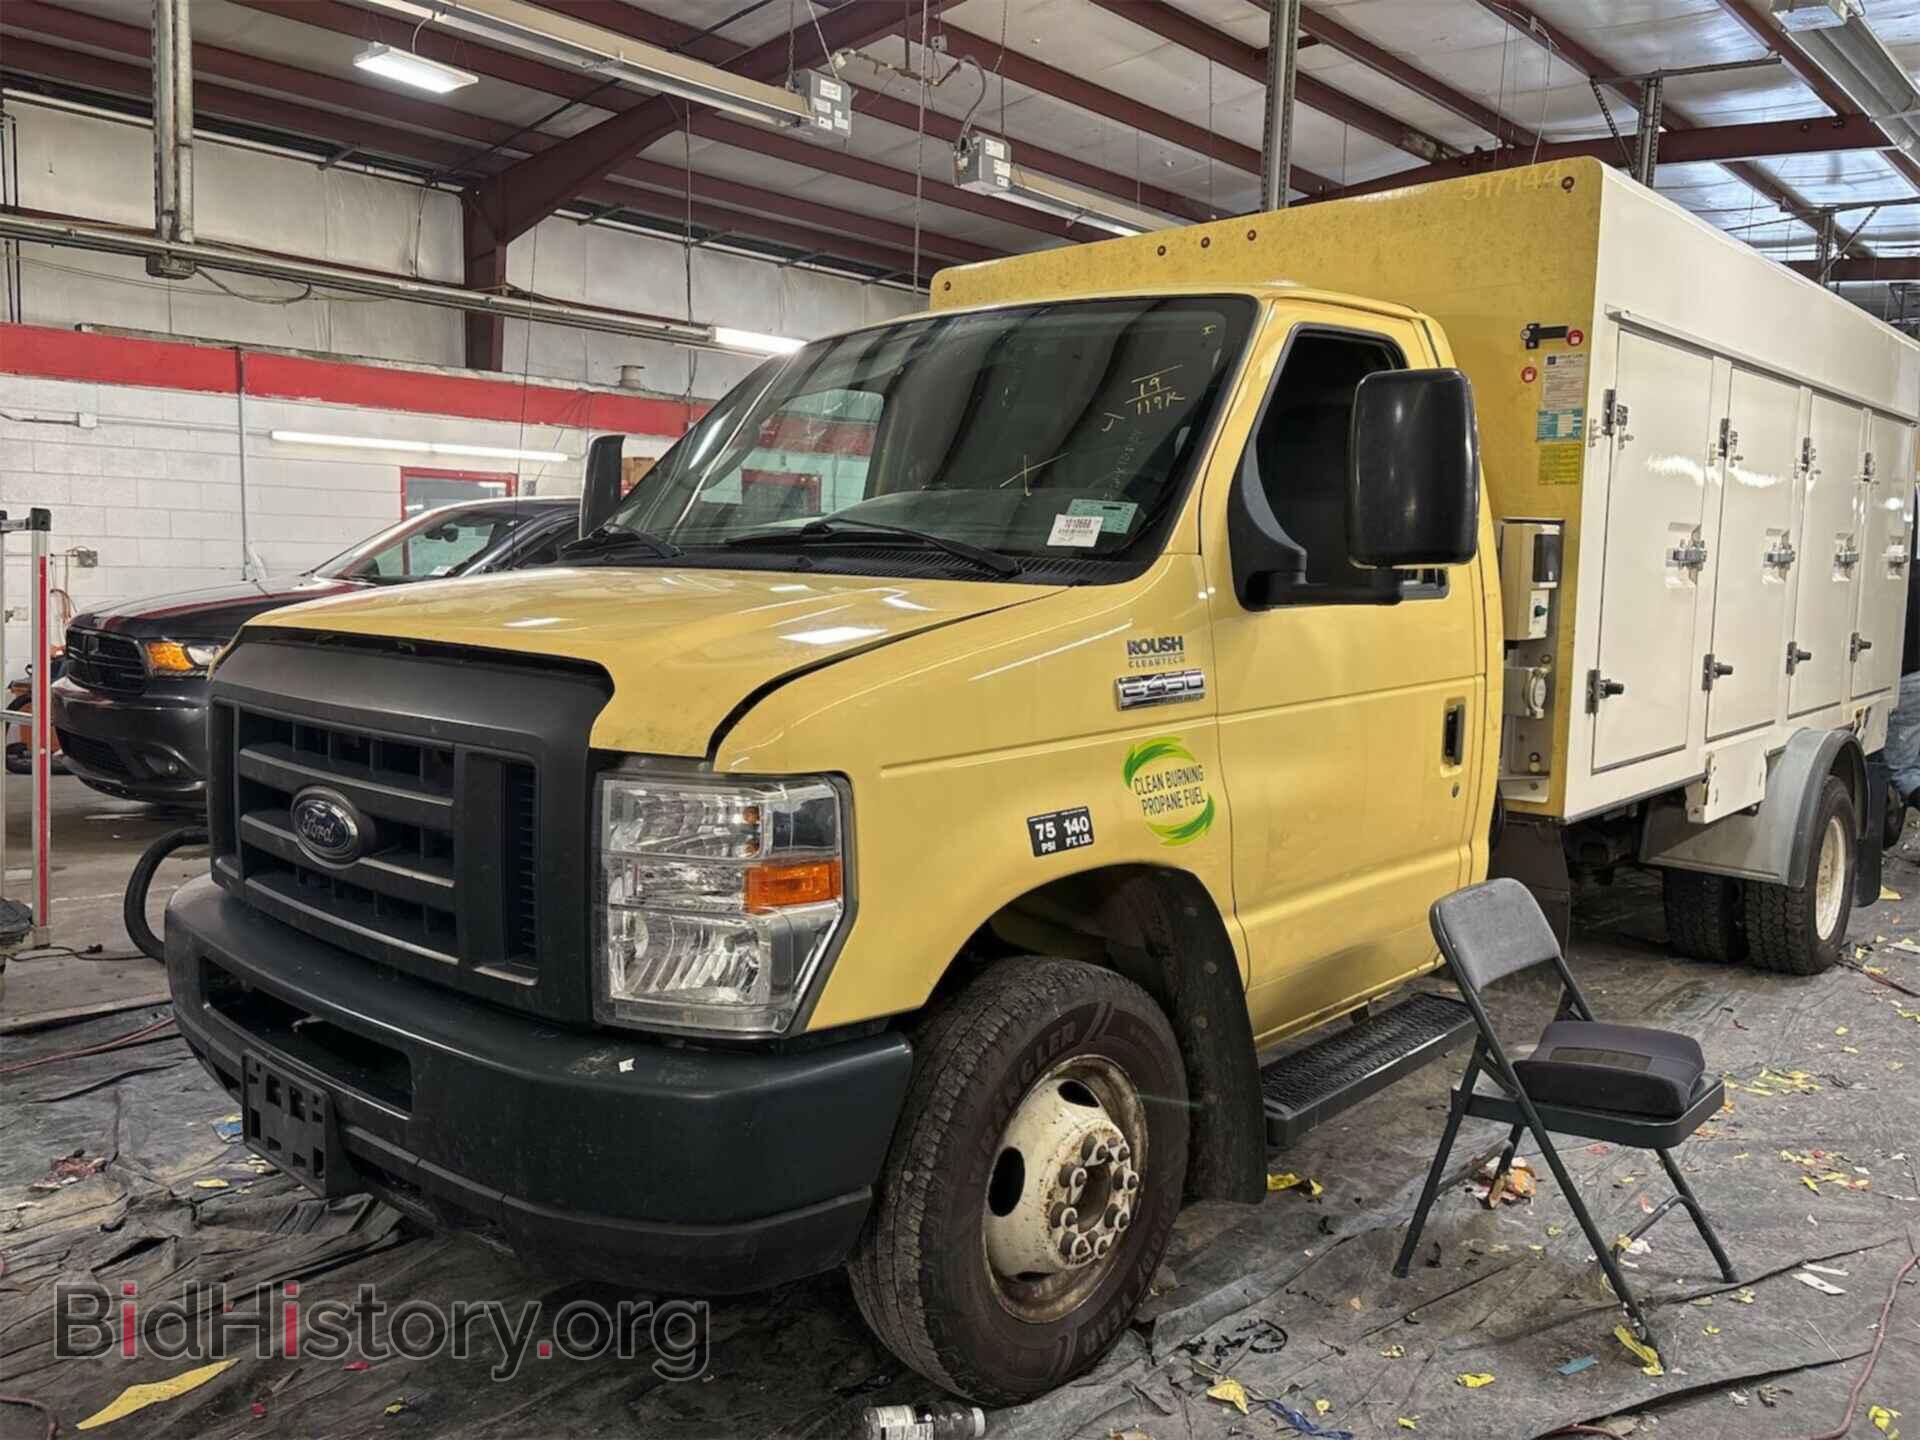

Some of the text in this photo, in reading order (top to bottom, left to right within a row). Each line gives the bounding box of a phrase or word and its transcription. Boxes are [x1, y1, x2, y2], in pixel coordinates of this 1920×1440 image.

[1127, 636, 1184, 655] ROUSH
[1134, 764, 1204, 795] CLEAN BURNING
[1141, 786, 1206, 816] PROPANE FUEL
[302, 806, 337, 842] Ford
[1035, 816, 1090, 840] 75 140
[1041, 840, 1056, 853] PSI
